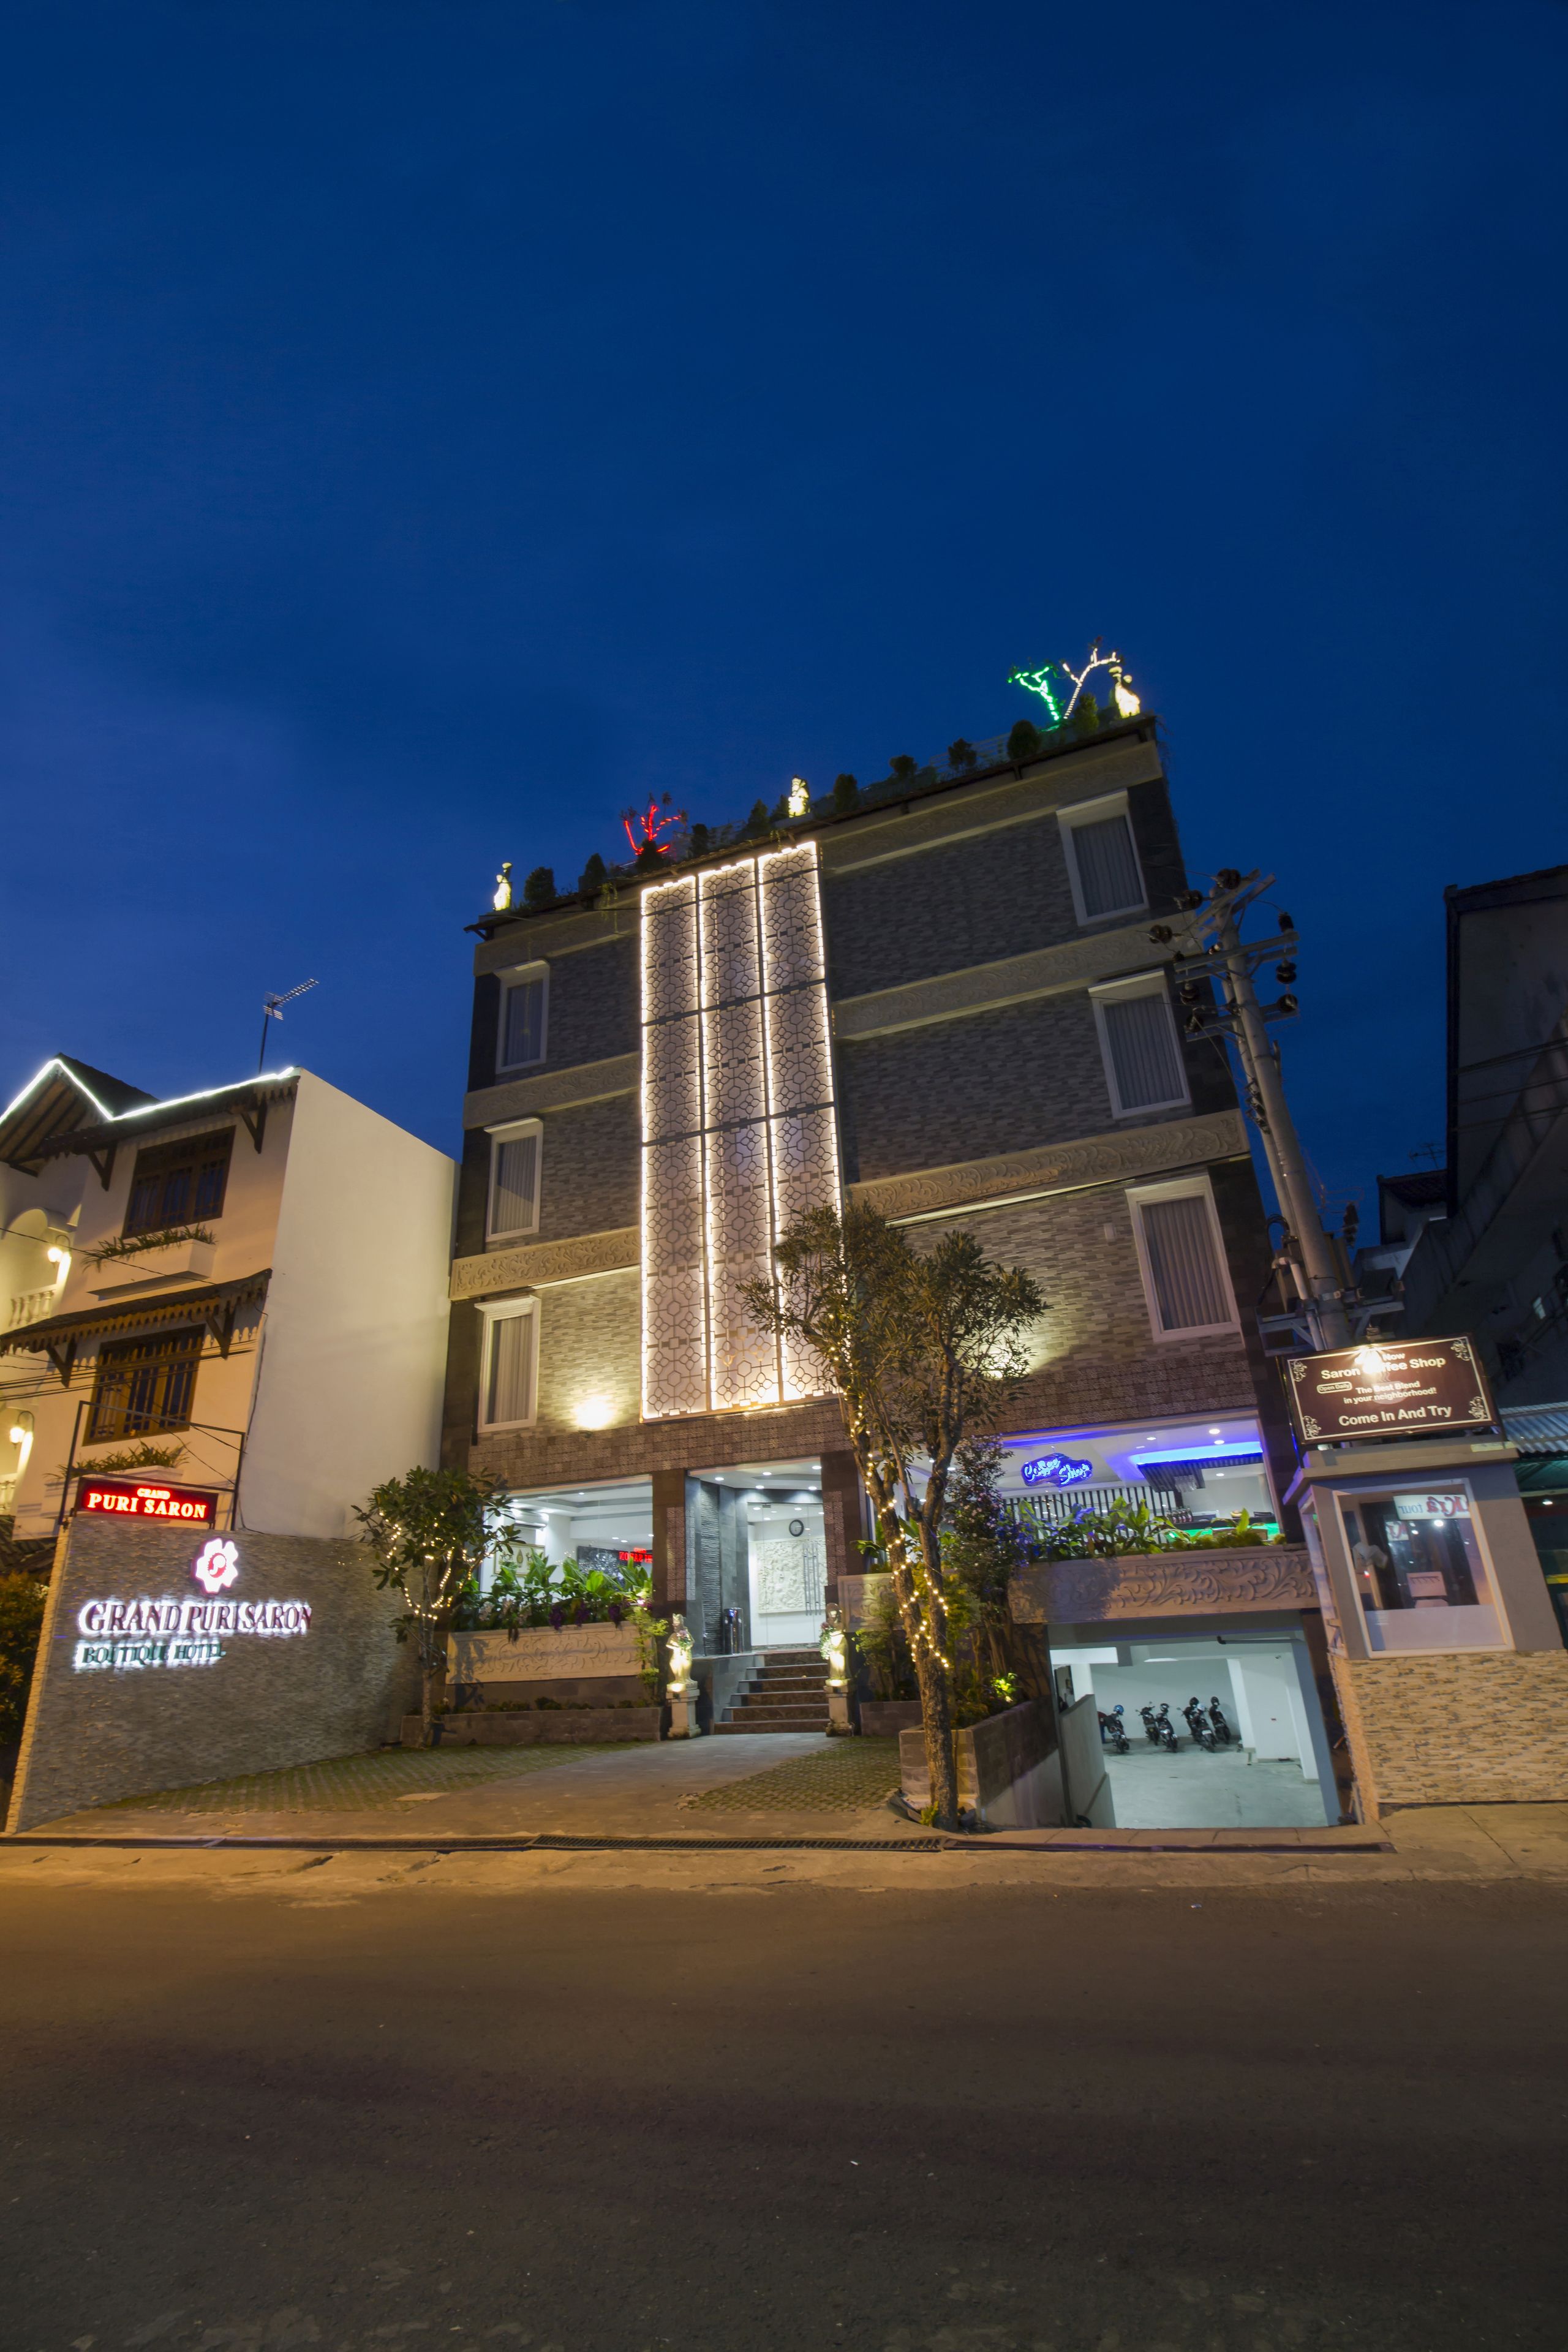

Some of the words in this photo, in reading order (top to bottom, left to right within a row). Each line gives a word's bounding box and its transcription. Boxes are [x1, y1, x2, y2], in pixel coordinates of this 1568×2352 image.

[1321, 1367, 1361, 1379] Saron
[1363, 1361, 1408, 1374] ffee
[1409, 1357, 1446, 1369] Shop
[1353, 1395, 1373, 1404] your
[1373, 1387, 1437, 1401] neighborhood!
[1373, 1384, 1394, 1393] Best
[1394, 1380, 1420, 1390] Blend
[1338, 1414, 1379, 1427] Come
[1380, 1411, 1396, 1422] In
[1398, 1406, 1427, 1420] And
[1427, 1405, 1452, 1418] Try
[137, 1488, 171, 1500] GRAND
[87, 1493, 139, 1512] PURI
[143, 1499, 207, 1518] SARON
[82, 1601, 182, 1632] GRAND
[183, 1602, 239, 1631] PURI
[241, 1603, 312, 1631] SARON
[81, 1643, 170, 1665] BOUTIQUE
[173, 1641, 227, 1660] HOTEL
